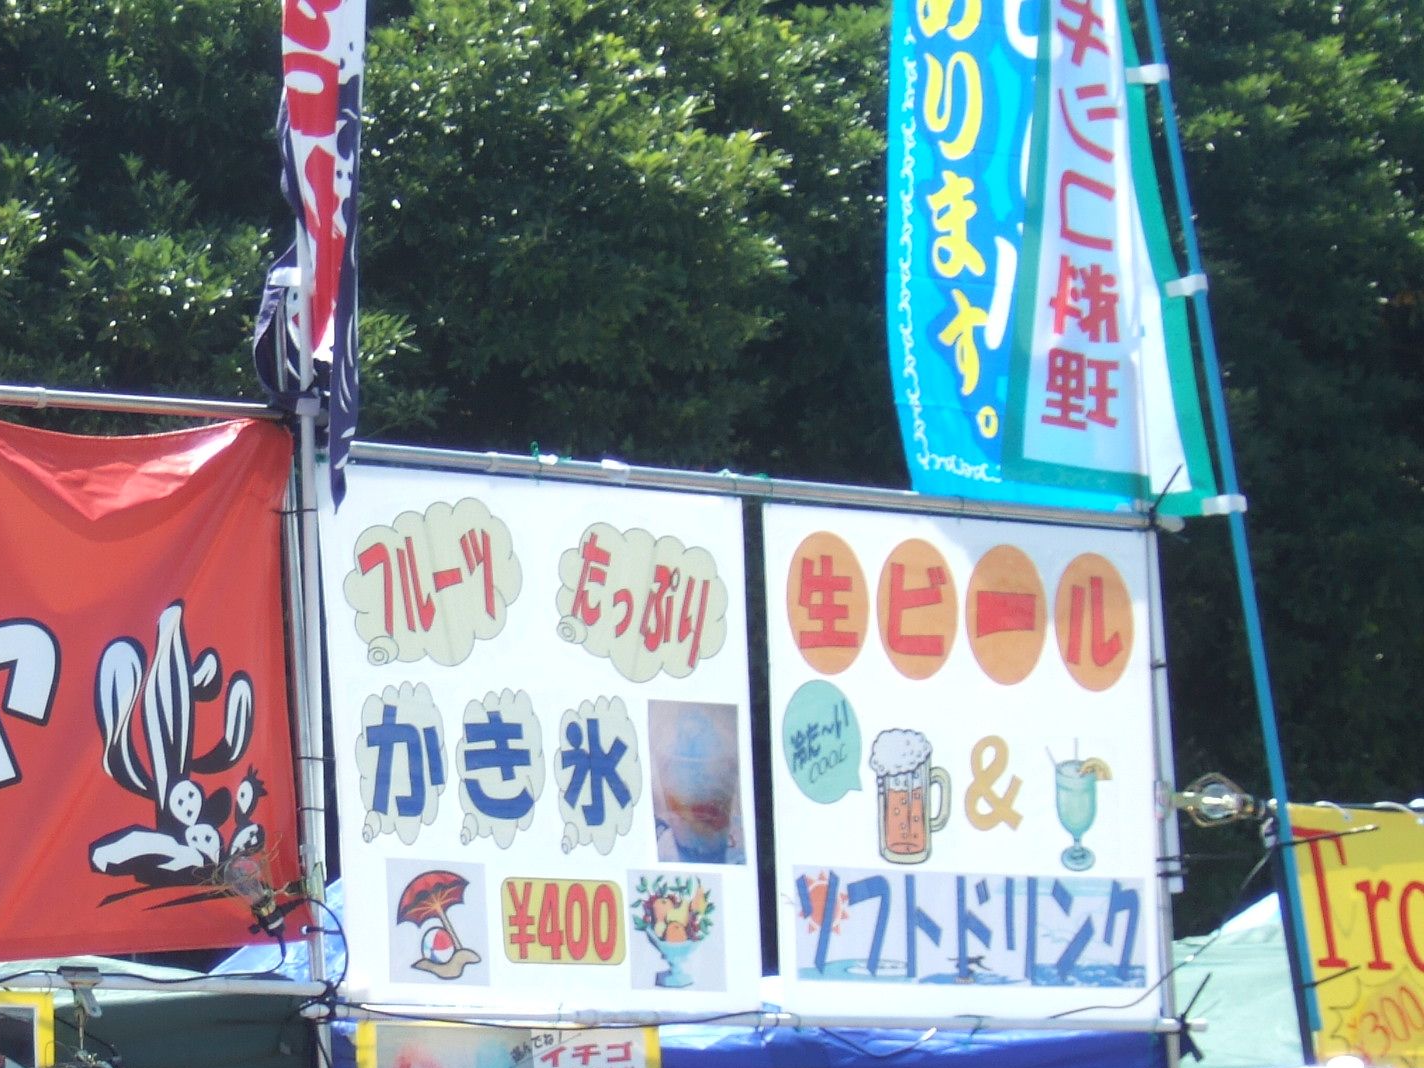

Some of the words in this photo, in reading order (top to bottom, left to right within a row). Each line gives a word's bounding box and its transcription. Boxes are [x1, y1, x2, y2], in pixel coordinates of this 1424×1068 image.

[358, 528, 496, 637] フルーツ
[570, 532, 710, 669] たっぷり
[798, 555, 1124, 668] 生ビール
[365, 704, 634, 826] かき氷
[965, 735, 1024, 831] &
[506, 881, 618, 961] ¥400
[796, 869, 1141, 980] ソフトドリンク
[540, 1042, 633, 1068] イチゴ
